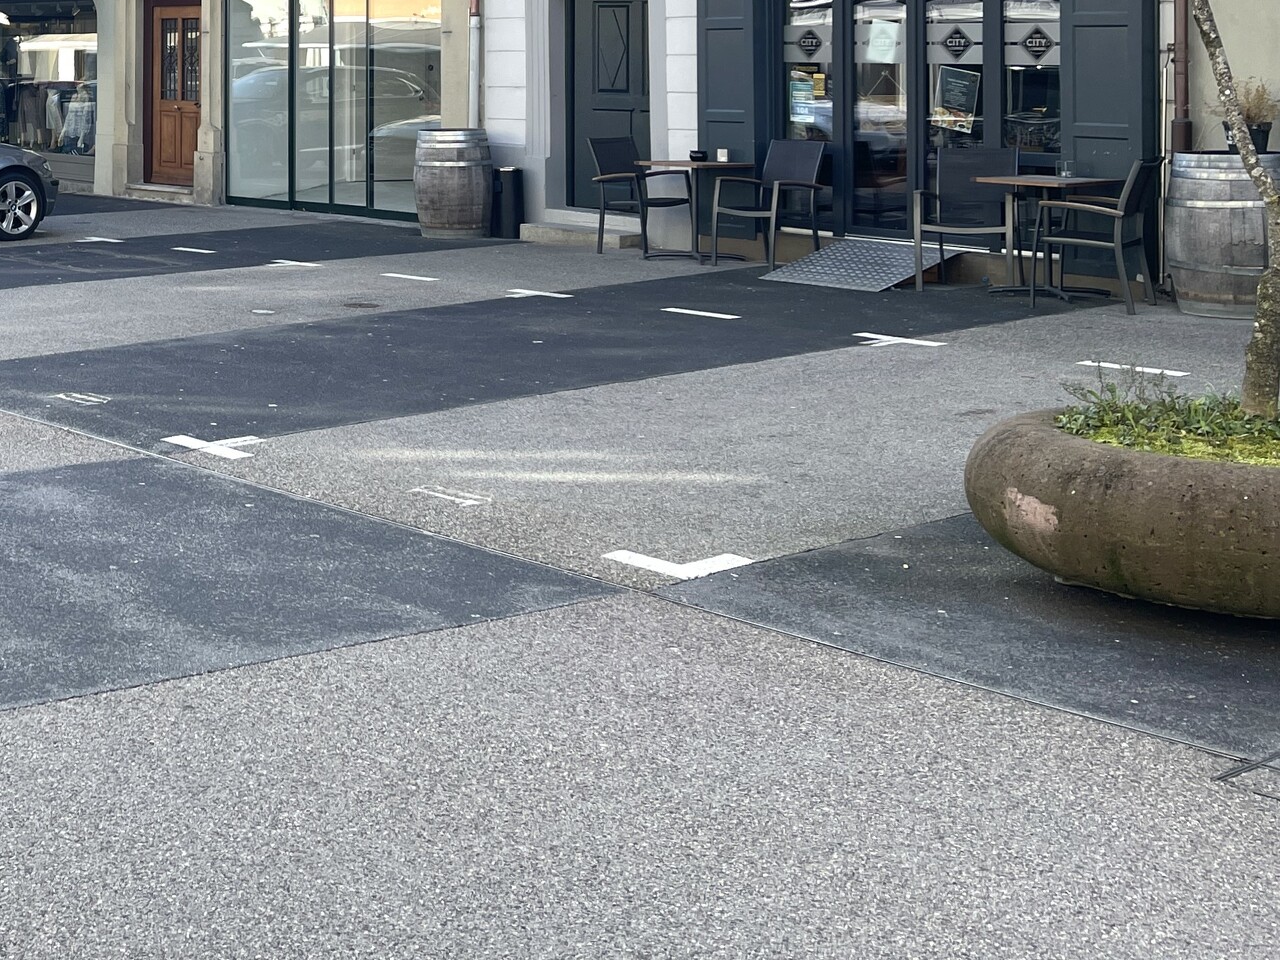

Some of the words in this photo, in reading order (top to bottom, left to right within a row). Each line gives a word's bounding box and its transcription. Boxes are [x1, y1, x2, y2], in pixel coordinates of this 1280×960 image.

[800, 38, 817, 46] CITY
[946, 38, 966, 47] CITY
[1026, 38, 1047, 47] CITY
